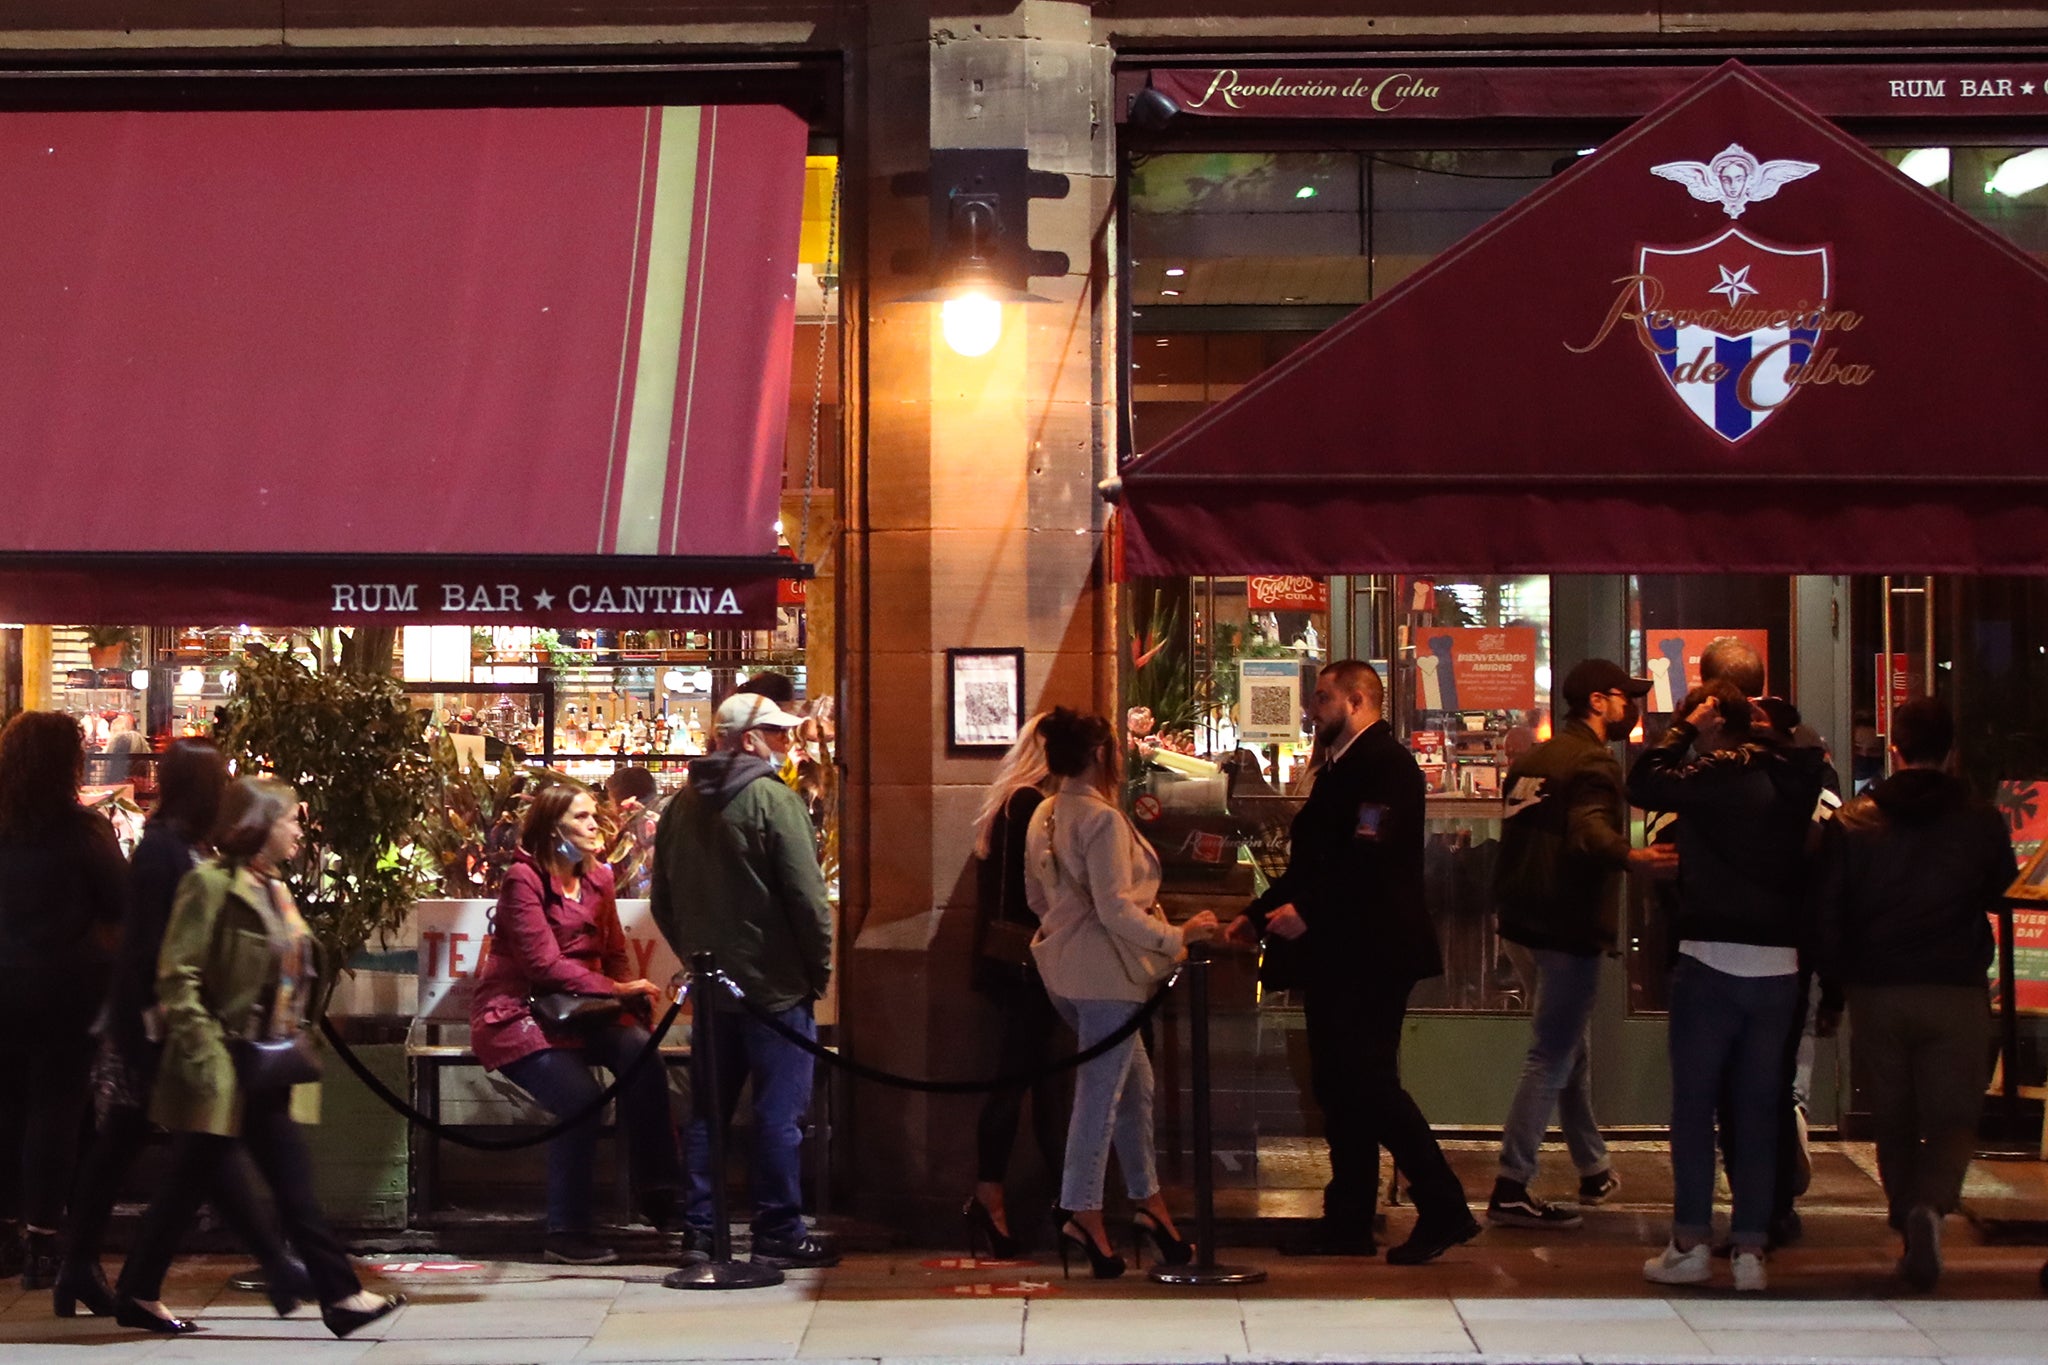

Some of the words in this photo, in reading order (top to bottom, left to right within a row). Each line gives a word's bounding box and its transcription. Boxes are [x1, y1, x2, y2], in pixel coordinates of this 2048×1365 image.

[1186, 69, 1342, 109] Revolución
[1342, 77, 1369, 97] de
[1371, 73, 1441, 111] Cuba
[1888, 79, 1946, 97] RUM
[1959, 79, 2014, 97] BAR
[1563, 275, 1863, 354] Revolución
[1672, 346, 1729, 385] de
[1736, 339, 1874, 412] Cuba
[331, 583, 419, 612] RUM
[440, 583, 523, 612] BAR
[568, 584, 744, 615] CANTINA
[1284, 592, 1316, 601] CUBA
[1457, 653, 1527, 662] BIENVENIDOS
[1472, 663, 1513, 672] AMIGOS
[2012, 913, 2048, 925] EVER
[2016, 927, 2044, 939] DAY
